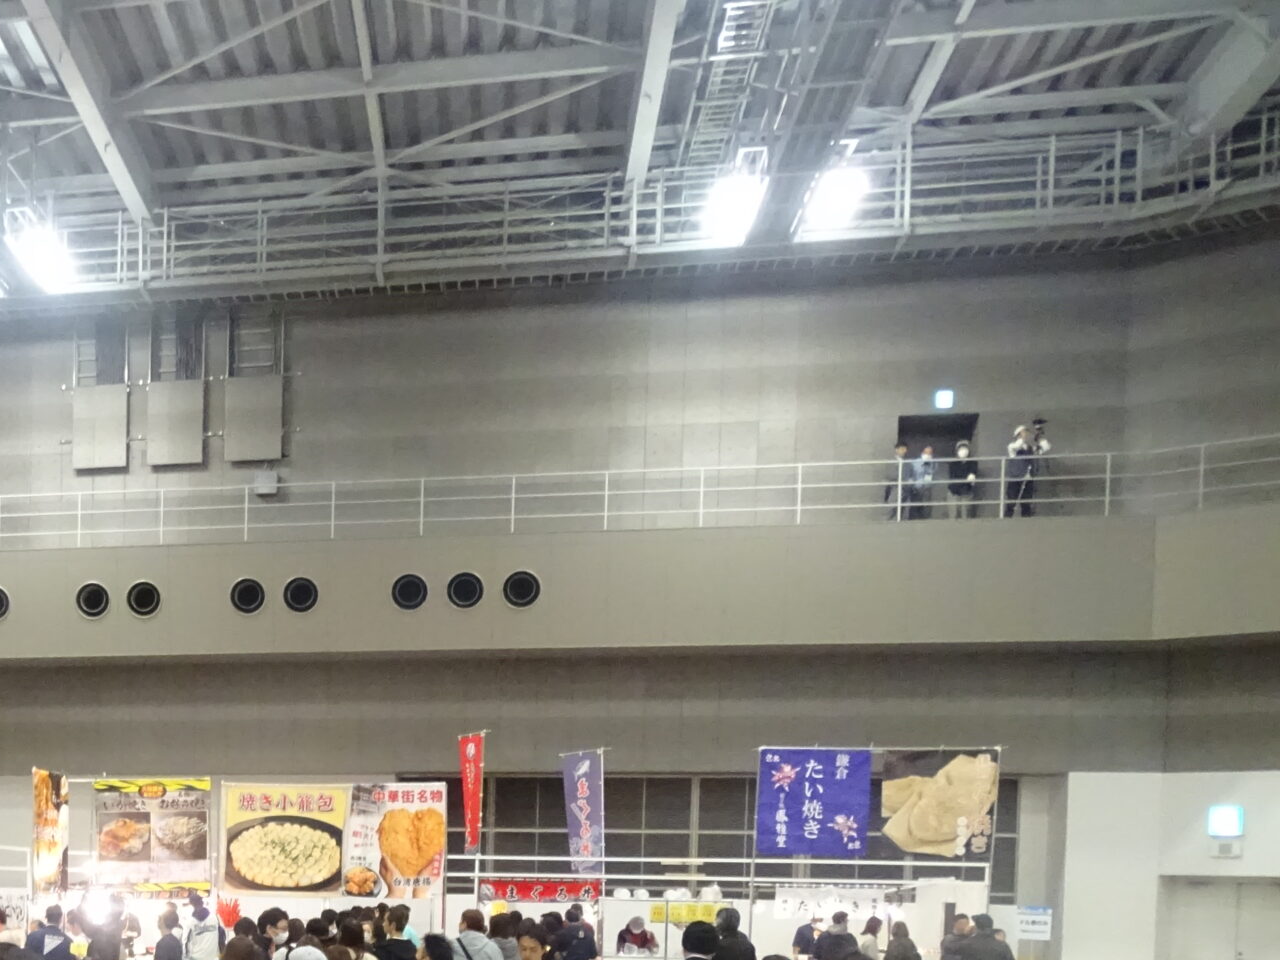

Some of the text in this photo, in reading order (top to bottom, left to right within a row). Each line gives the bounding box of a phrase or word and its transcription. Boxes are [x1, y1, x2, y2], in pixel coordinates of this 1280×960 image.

[372, 788, 444, 804] 中華街名物
[801, 758, 825, 840] たい焼き
[504, 884, 596, 902] まぐろ丼
